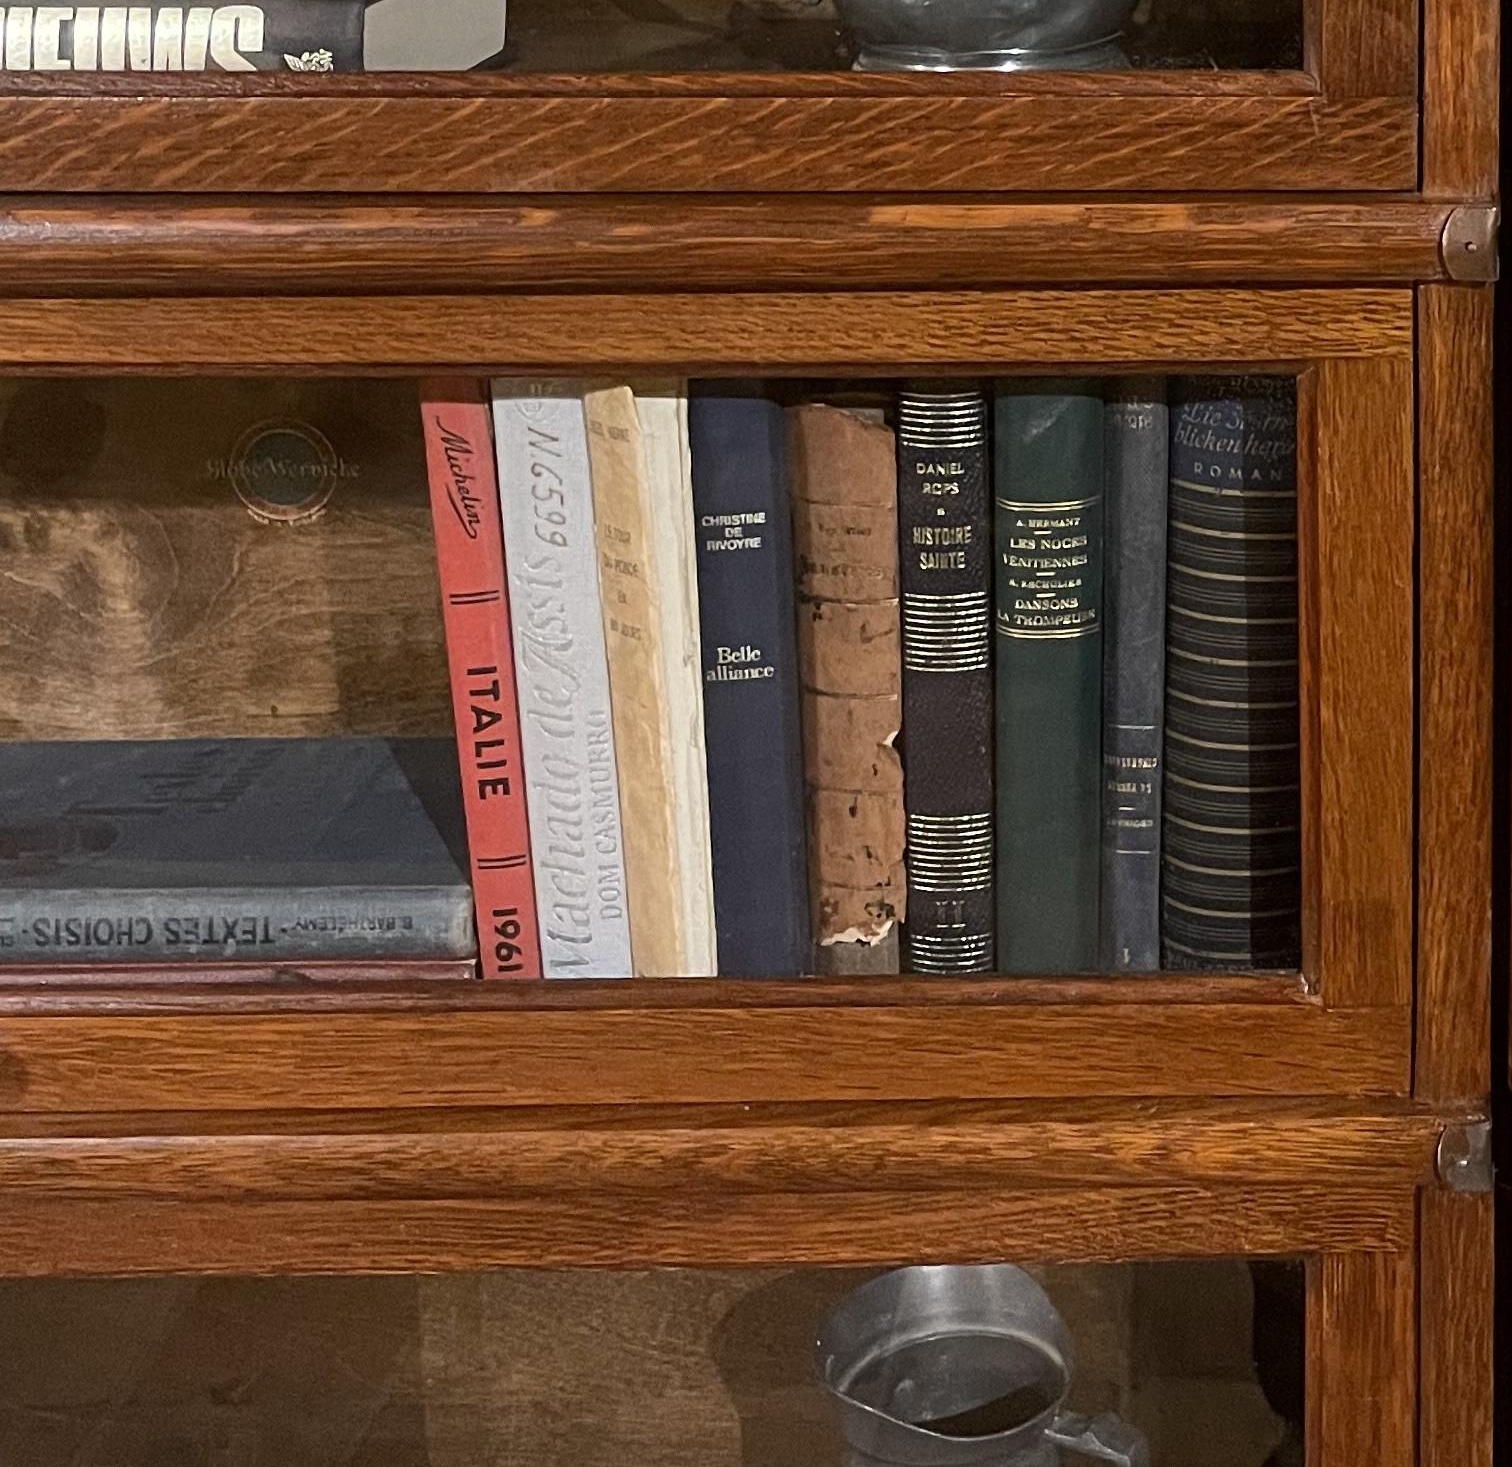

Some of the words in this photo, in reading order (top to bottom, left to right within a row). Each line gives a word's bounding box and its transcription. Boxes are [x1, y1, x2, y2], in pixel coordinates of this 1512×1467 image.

[1173, 421, 1242, 453] blicken
[436, 416, 482, 540] Michelin
[915, 462, 965, 476] DANIEL
[1193, 461, 1282, 481] ROMAN
[701, 511, 767, 527] CHRISTINE
[725, 526, 744, 538] DE
[912, 525, 972, 546] HISTOIRE
[1010, 537, 1036, 549] LES
[1040, 535, 1088, 550] NOCES
[706, 536, 762, 551] RIVOYRE
[919, 551, 966, 570] SAINTE
[1014, 597, 1079, 611] DANSONS
[513, 554, 581, 692] Assis
[716, 644, 761, 665] Belle
[706, 664, 775, 682] alliance
[528, 685, 580, 739] de
[466, 665, 511, 800] ITALIE
[531, 753, 593, 969] Machado
[599, 862, 623, 919] DOM
[32, 916, 154, 947] CHOISIS
[163, 915, 275, 946] TEXTES
[491, 907, 525, 973] 1961
